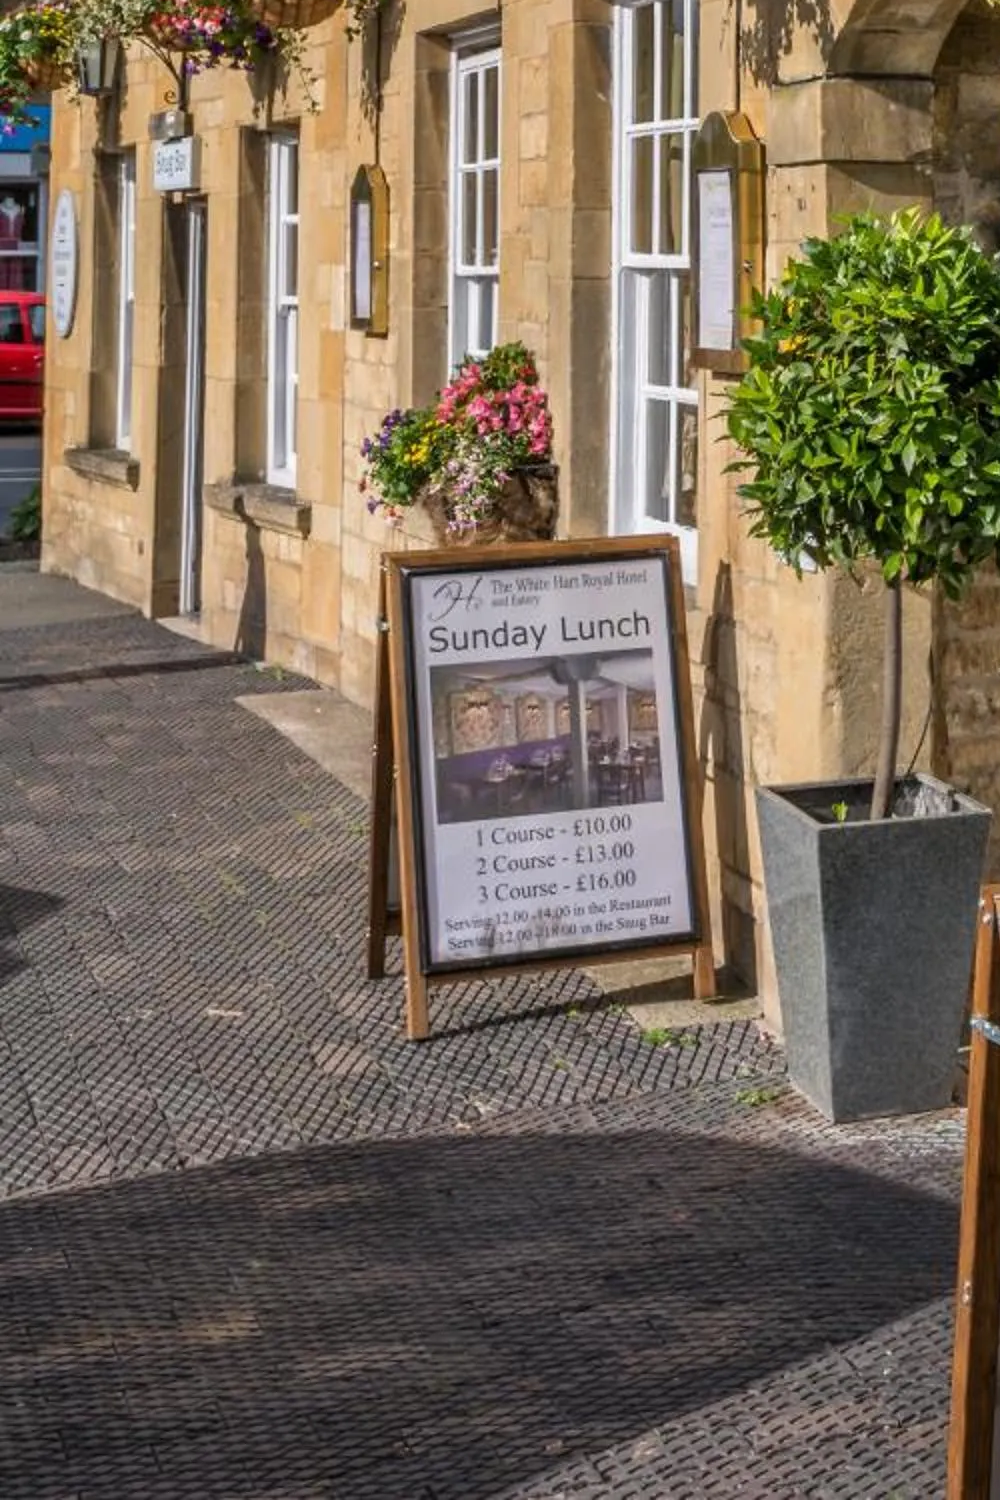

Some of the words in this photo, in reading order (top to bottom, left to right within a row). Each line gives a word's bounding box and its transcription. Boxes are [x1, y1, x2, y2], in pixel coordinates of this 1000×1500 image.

[429, 620, 547, 653] Sunday
[561, 609, 650, 642] Lunch
[476, 829, 484, 848] 1
[491, 824, 555, 846] Course
[573, 813, 632, 838] £10.00
[476, 857, 487, 876] 2
[493, 853, 556, 874] Course
[575, 841, 635, 865] £13.00
[478, 885, 489, 903] 3
[495, 880, 558, 903] Course
[576, 869, 637, 893] £16.00
[609, 894, 672, 913] Restaurant
